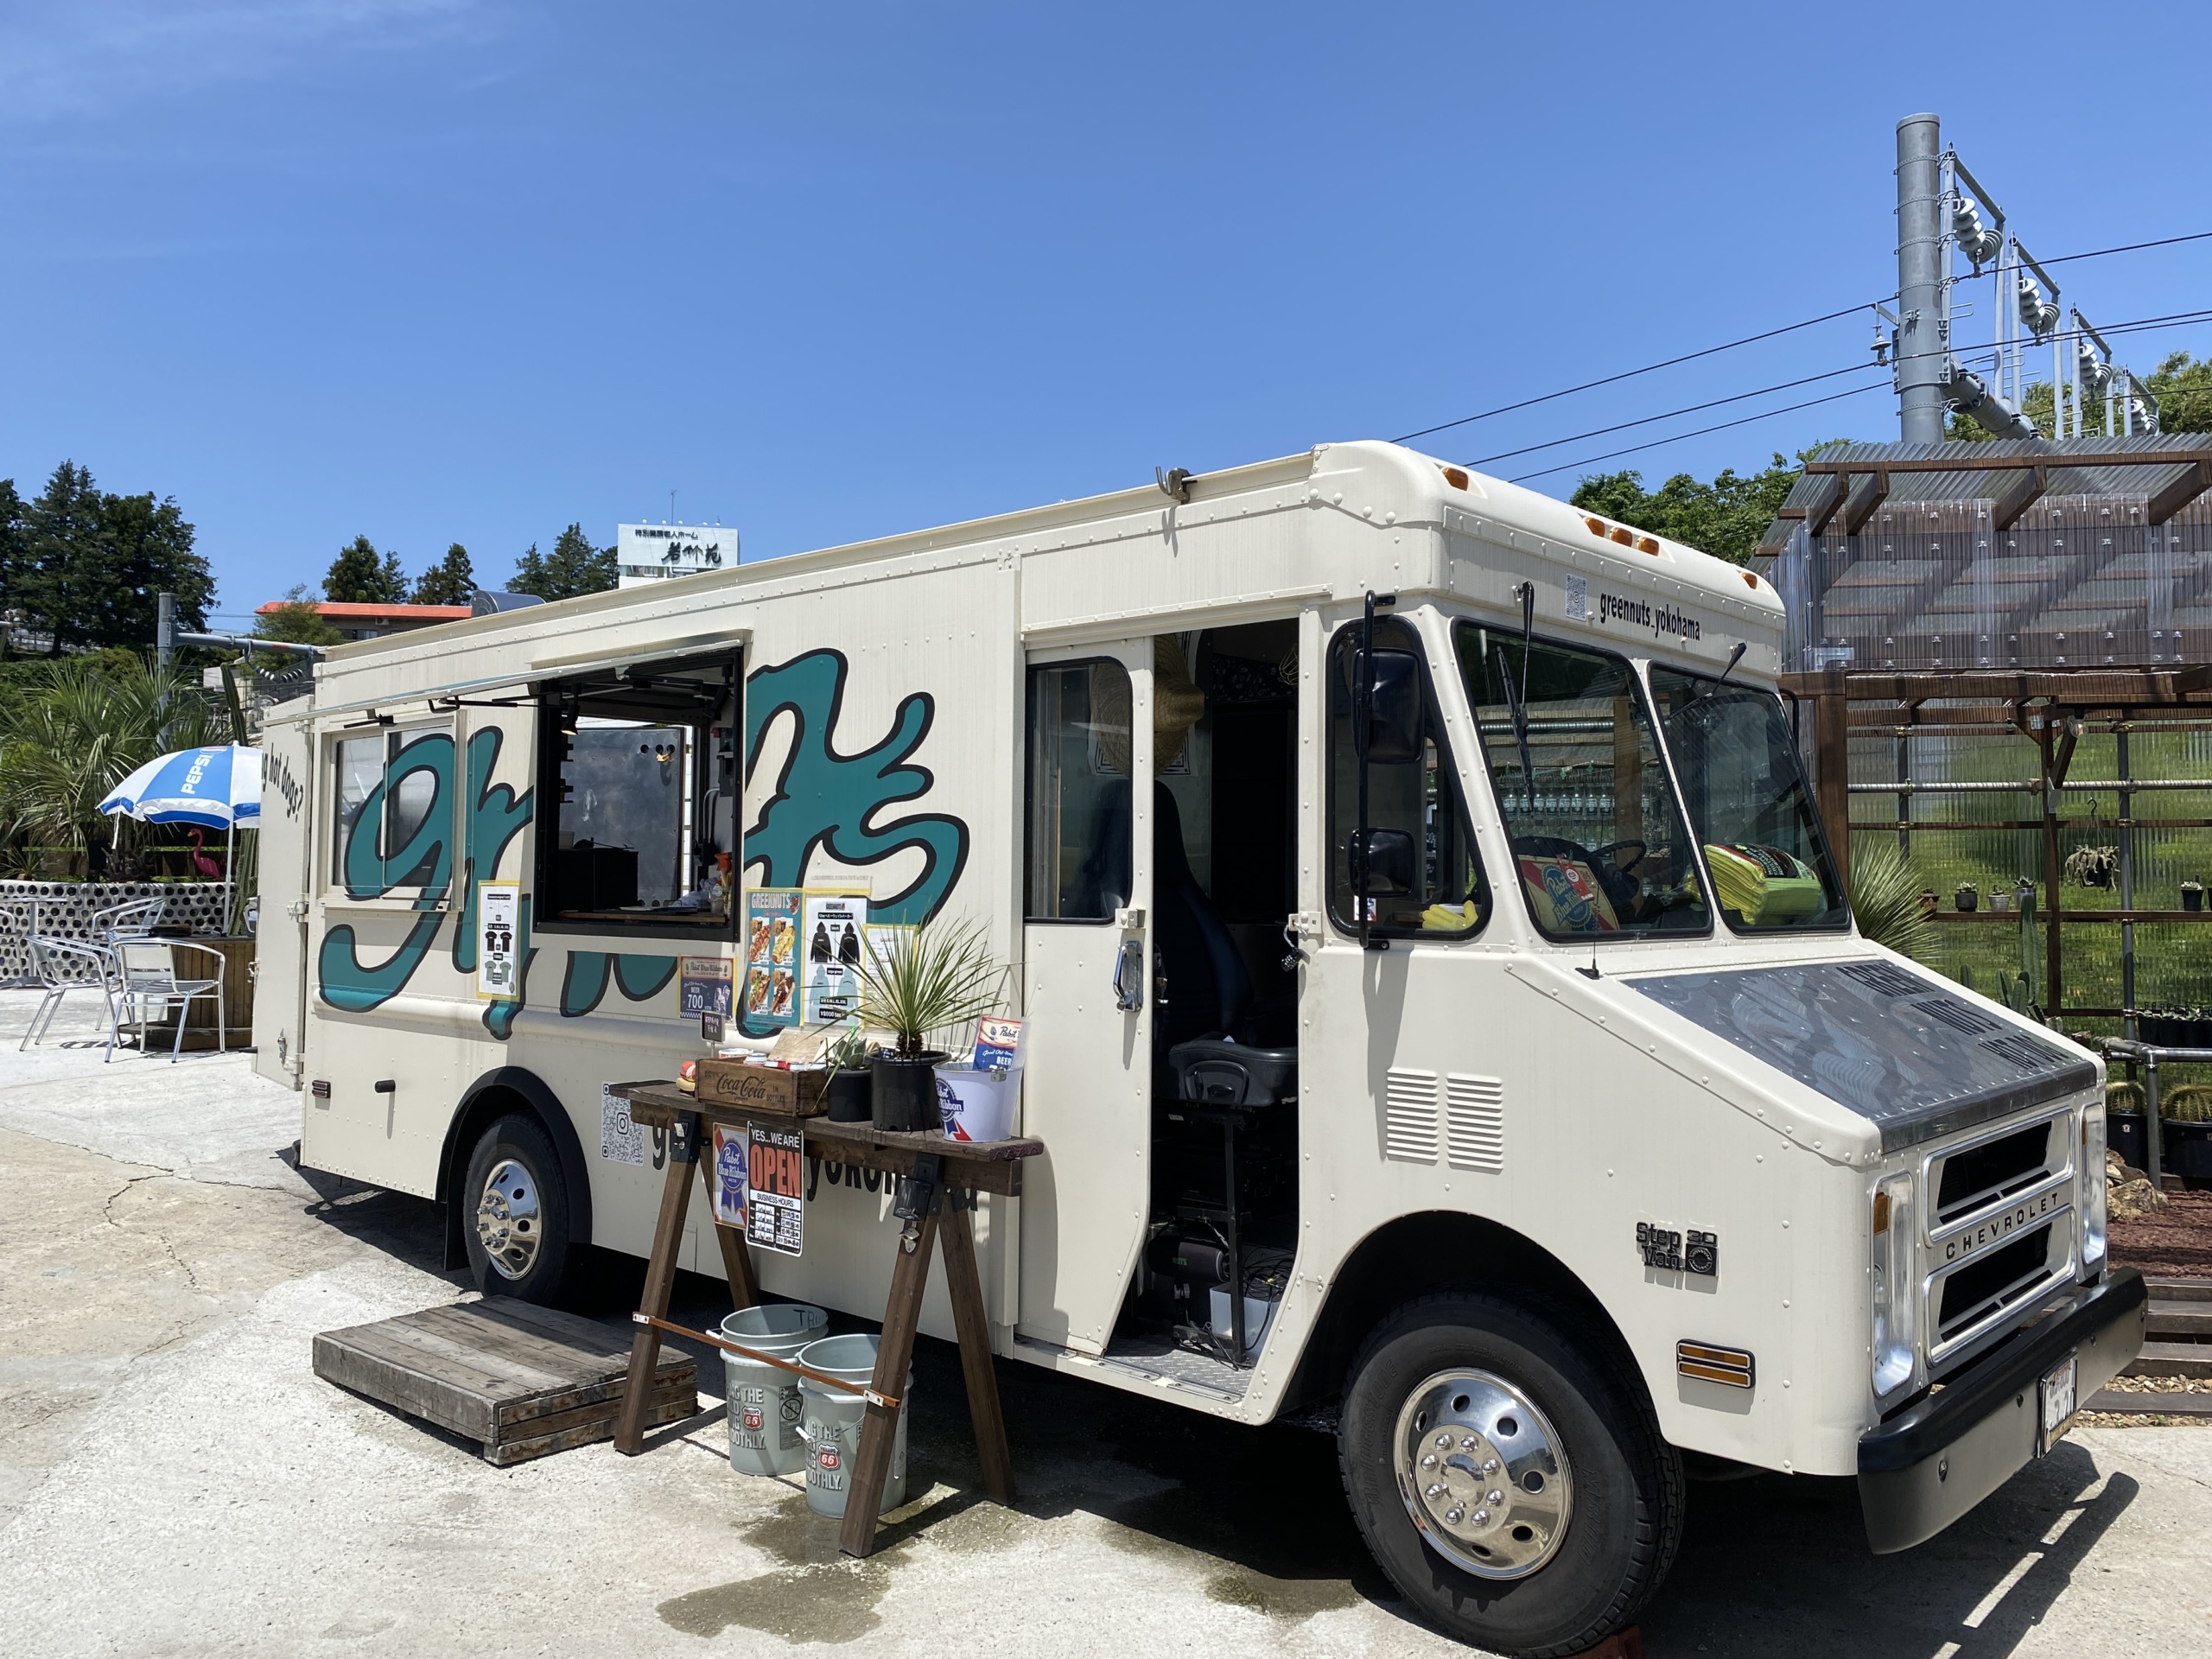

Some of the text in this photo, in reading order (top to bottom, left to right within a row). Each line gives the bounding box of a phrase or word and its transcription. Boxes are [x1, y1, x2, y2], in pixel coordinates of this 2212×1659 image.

[1600, 592, 1700, 641] greennuts_yokohama
[180, 753, 215, 795] PEPSI
[270, 742, 283, 788] hot
[281, 755, 304, 823] dogs?
[688, 994, 703, 1009] 700
[1000, 1027, 1017, 1038] Pabst
[996, 1056, 1012, 1065] BEER
[783, 1135, 800, 1148] ARE
[724, 1147, 741, 1165] Pabst
[718, 1163, 729, 1175] Blue
[750, 1144, 801, 1198] OPEN
[757, 1192, 794, 1208] BUSINESS HOURS
[1946, 1192, 2058, 1260] CHEVROLET
[1636, 1222, 1681, 1253] Step
[1642, 1245, 1682, 1270] Van
[741, 1388, 764, 1403] THE
[745, 1415, 759, 1426] 66
[821, 1454, 835, 1465] 66
